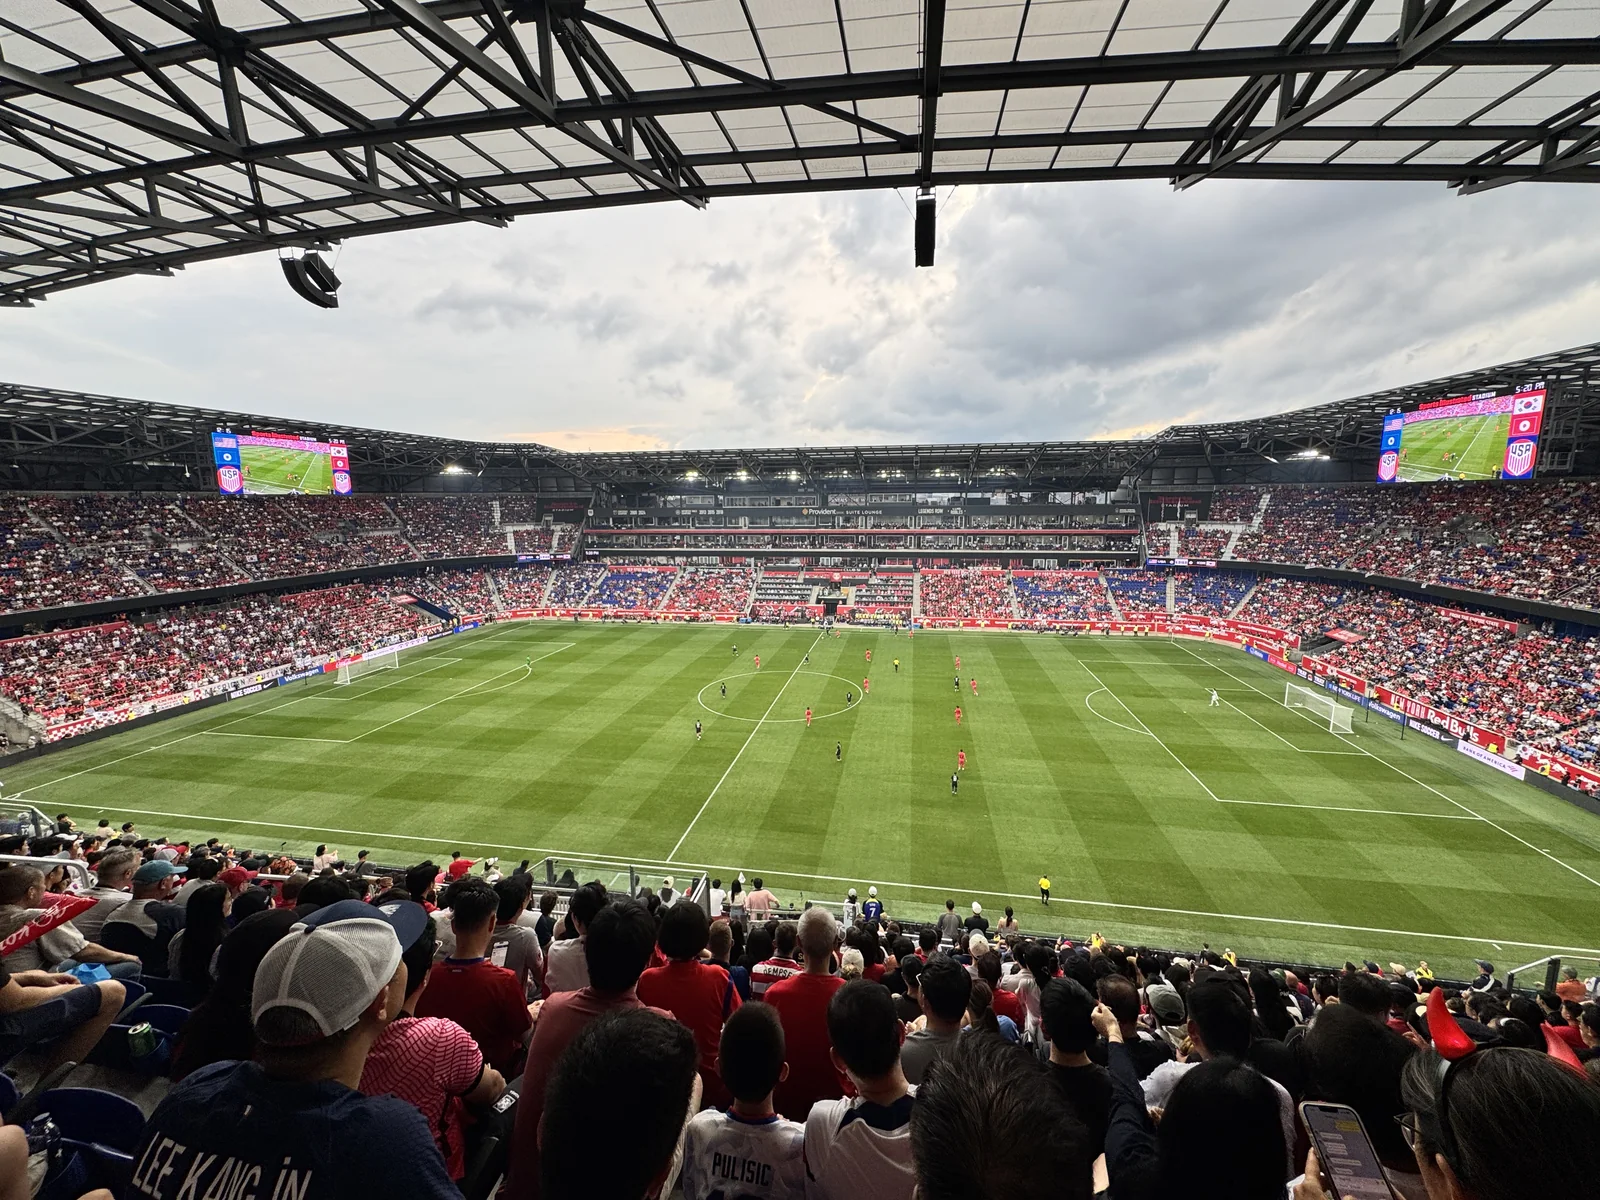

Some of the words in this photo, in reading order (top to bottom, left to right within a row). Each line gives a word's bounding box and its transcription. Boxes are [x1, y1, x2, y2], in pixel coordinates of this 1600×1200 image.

[1516, 384, 1532, 393] 5:20
[1534, 382, 1545, 390] PM
[1472, 392, 1496, 401] STADIUM
[1511, 444, 1532, 457] USA
[1382, 455, 1395, 466] USA
[222, 470, 237, 478] USA
[284, 668, 319, 682] Volkswagen
[1369, 701, 1401, 720] Volkswagen
[1390, 694, 1404, 711] NEW
[1406, 699, 1426, 719] YORK
[1428, 709, 1450, 730] Red
[1409, 719, 1421, 731] NIKE
[1421, 724, 1440, 739] SOCCER
[1463, 746, 1476, 755] BANK
[1484, 756, 1506, 768] AMERICA
[869, 908, 876, 917] 7
[763, 967, 793, 978] DEMPSE
[132, 1131, 187, 1200] LEE
[176, 1152, 262, 1200] KANG
[712, 1152, 771, 1186] PULISIC
